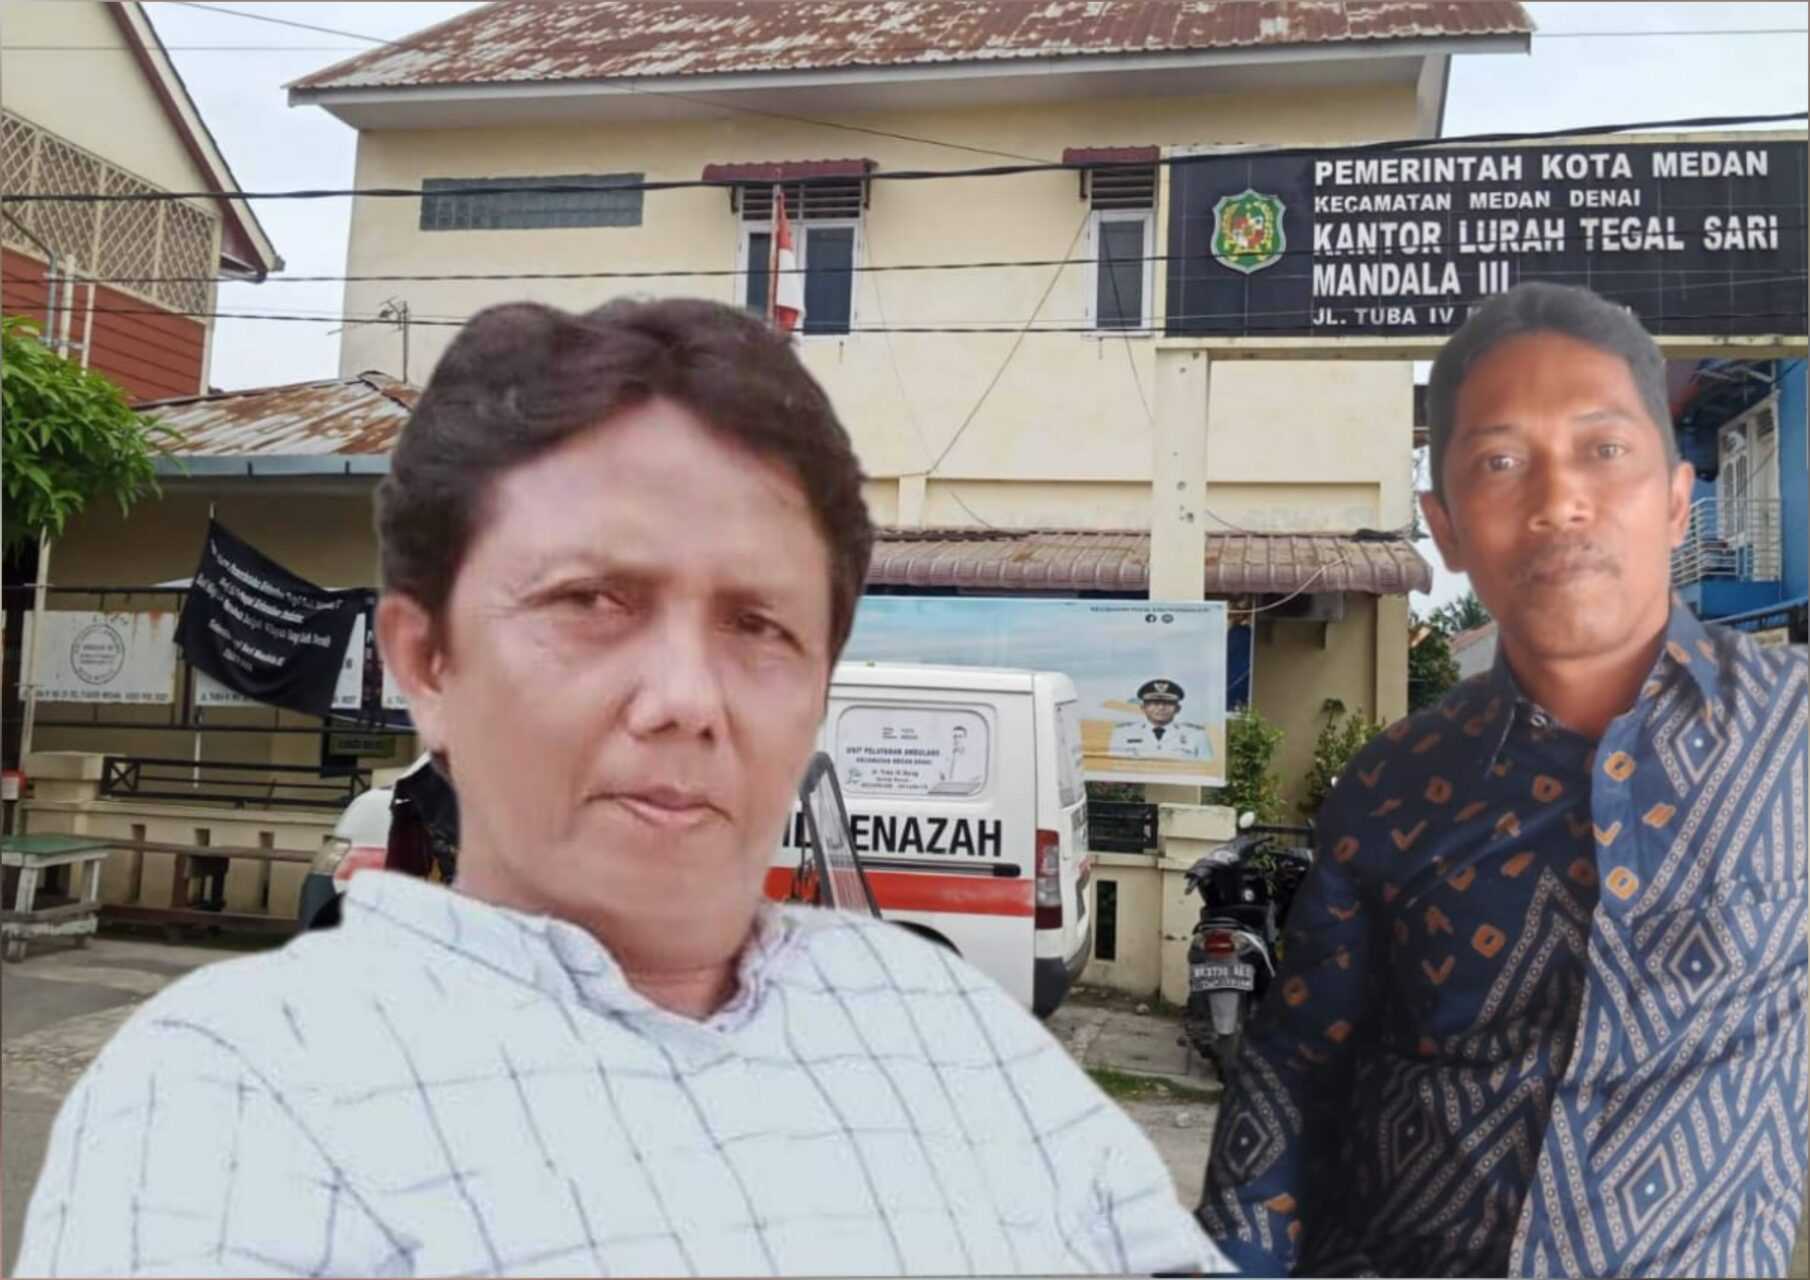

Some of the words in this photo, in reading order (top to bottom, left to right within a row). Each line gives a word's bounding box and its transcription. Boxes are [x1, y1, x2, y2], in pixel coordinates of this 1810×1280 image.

[1315, 155, 1522, 185] PEMERINTAH
[1542, 153, 1633, 179] KOTA
[1652, 151, 1768, 178] MEDAN
[1314, 193, 1451, 213] KECAMATAN
[1470, 191, 1550, 209] MEDAN
[1569, 189, 1640, 207] DENAI
[1313, 221, 1442, 256] KANTOR
[1459, 218, 1565, 253] LURAH
[1580, 216, 1685, 251] TEGAL
[1703, 215, 1778, 249] SARI
[1313, 261, 1461, 297] MANDALA
[1479, 261, 1509, 294] III
[1313, 308, 1347, 325] JL.
[1354, 308, 1416, 325] TUBA
[1429, 308, 1454, 324] IV
